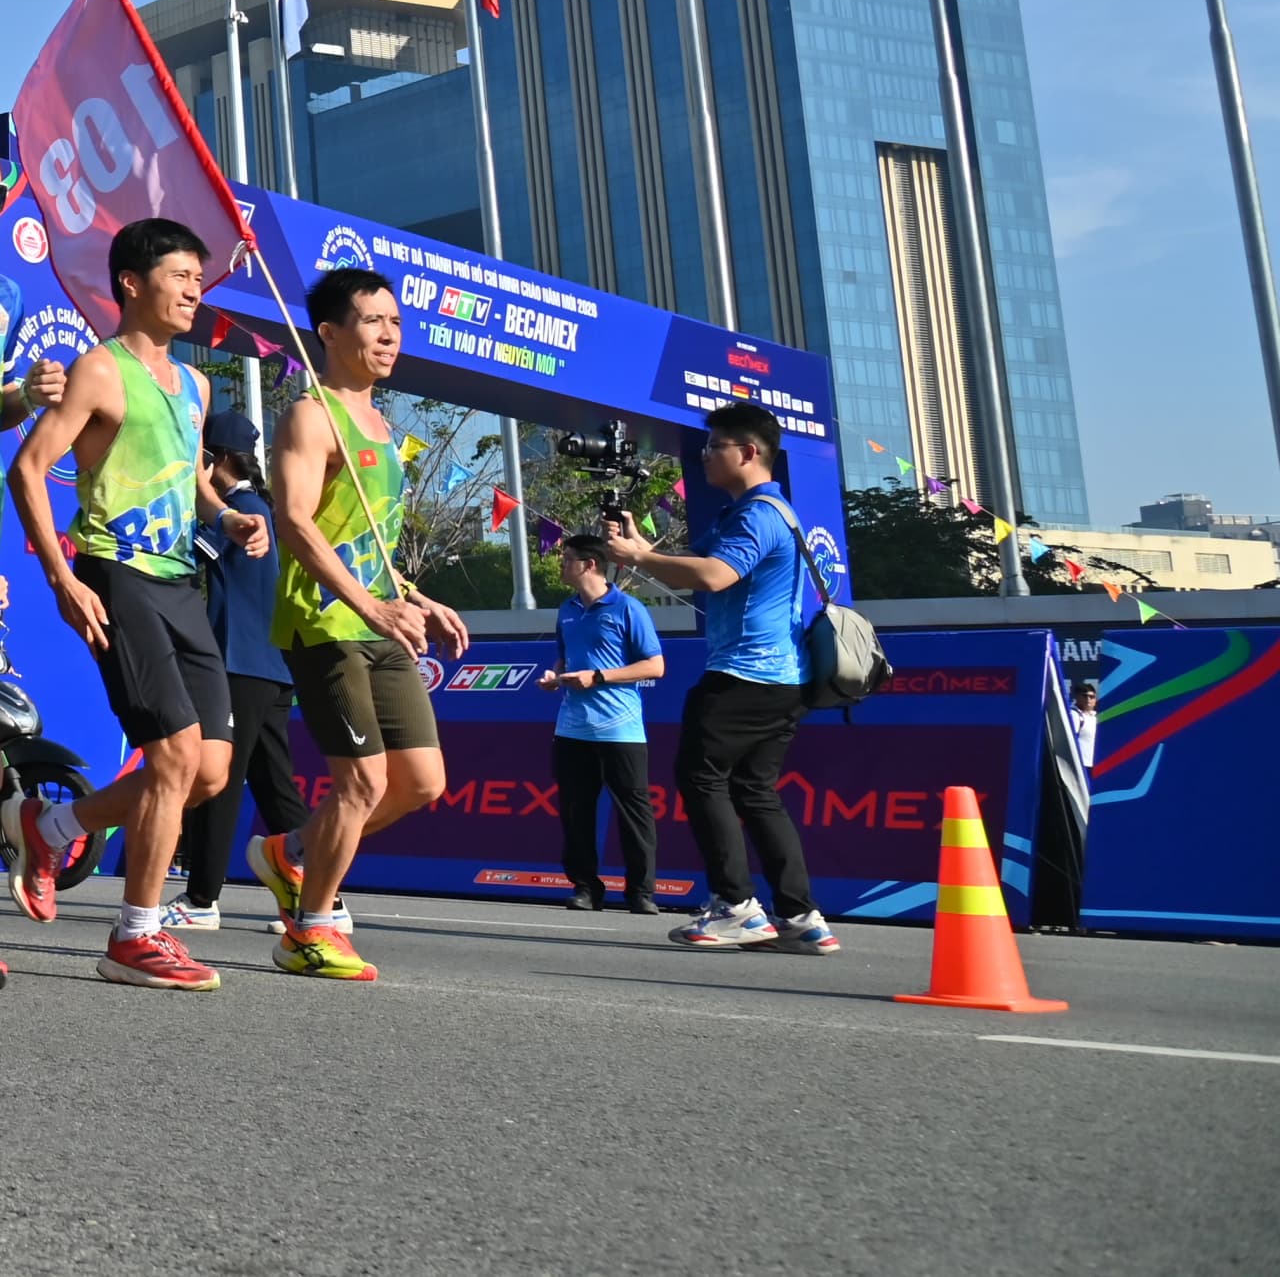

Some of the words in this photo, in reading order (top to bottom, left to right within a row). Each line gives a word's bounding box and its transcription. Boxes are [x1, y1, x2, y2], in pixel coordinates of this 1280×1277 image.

[56, 308, 86, 332] CHÀO
[401, 273, 438, 311] CÚP
[440, 289, 490, 324] HTV
[504, 303, 579, 352] BECAMEX
[58, 329, 77, 348] CHÍ
[454, 329, 475, 355] VÀO
[494, 340, 535, 371] NGUYÊN
[448, 666, 533, 689] HTV
